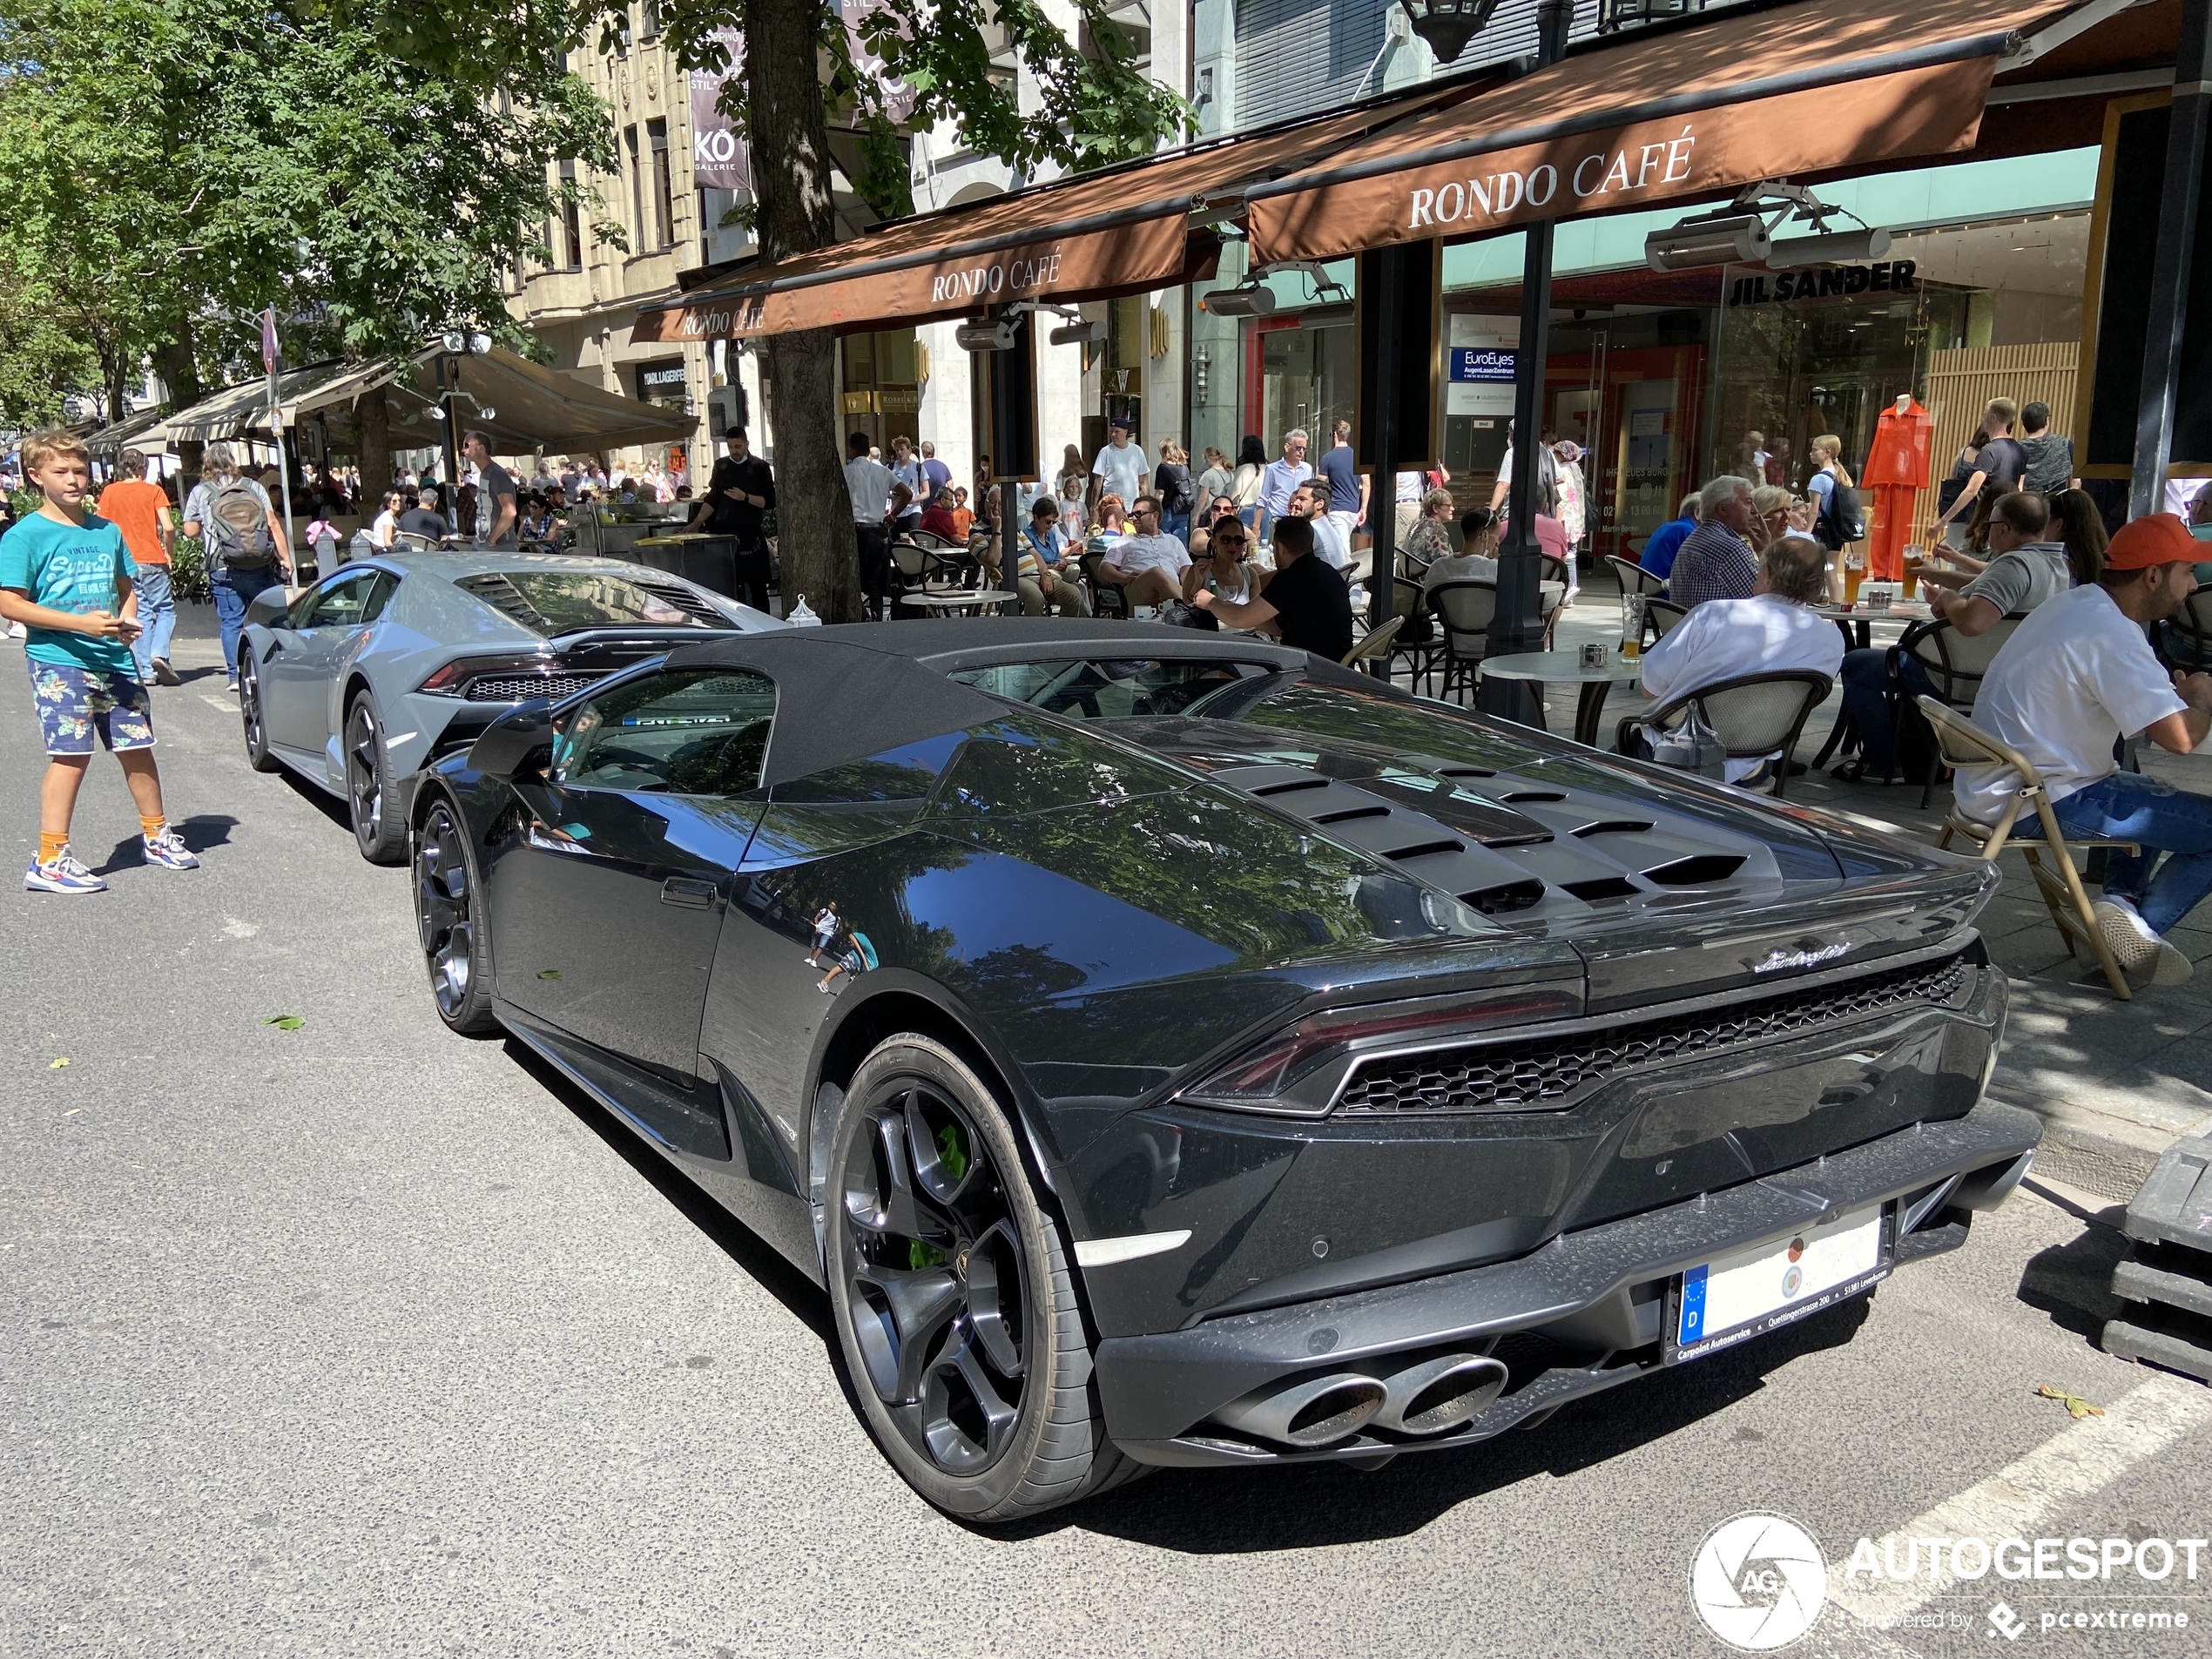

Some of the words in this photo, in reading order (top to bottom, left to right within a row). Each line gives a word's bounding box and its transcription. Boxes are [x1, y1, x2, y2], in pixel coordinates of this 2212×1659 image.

[1408, 163, 1557, 229] RONDO
[1572, 124, 1696, 198] CAFÉ
[931, 265, 1004, 303] RONDO
[1009, 246, 1062, 290] CAFÉ
[1729, 276, 1770, 307] JIL
[1773, 260, 1916, 302] SANDER
[681, 311, 730, 335] RONDO
[732, 300, 765, 331] CAFÉ
[1465, 351, 1514, 368] EuroEyes
[644, 372, 659, 385] KARL
[67, 545, 100, 555] VINTAGE
[47, 597, 101, 606] PREMIUM
[1677, 1342, 1710, 1360] Carpoint
[1710, 1328, 1751, 1349] Autoservice
[1768, 1299, 1818, 1327] Quettingerstrasse
[1819, 1295, 1830, 1307] 200
[1844, 1283, 1860, 1296] 51381
[1860, 1269, 1887, 1289] Leverkusen
[1688, 1311, 1697, 1328] D
